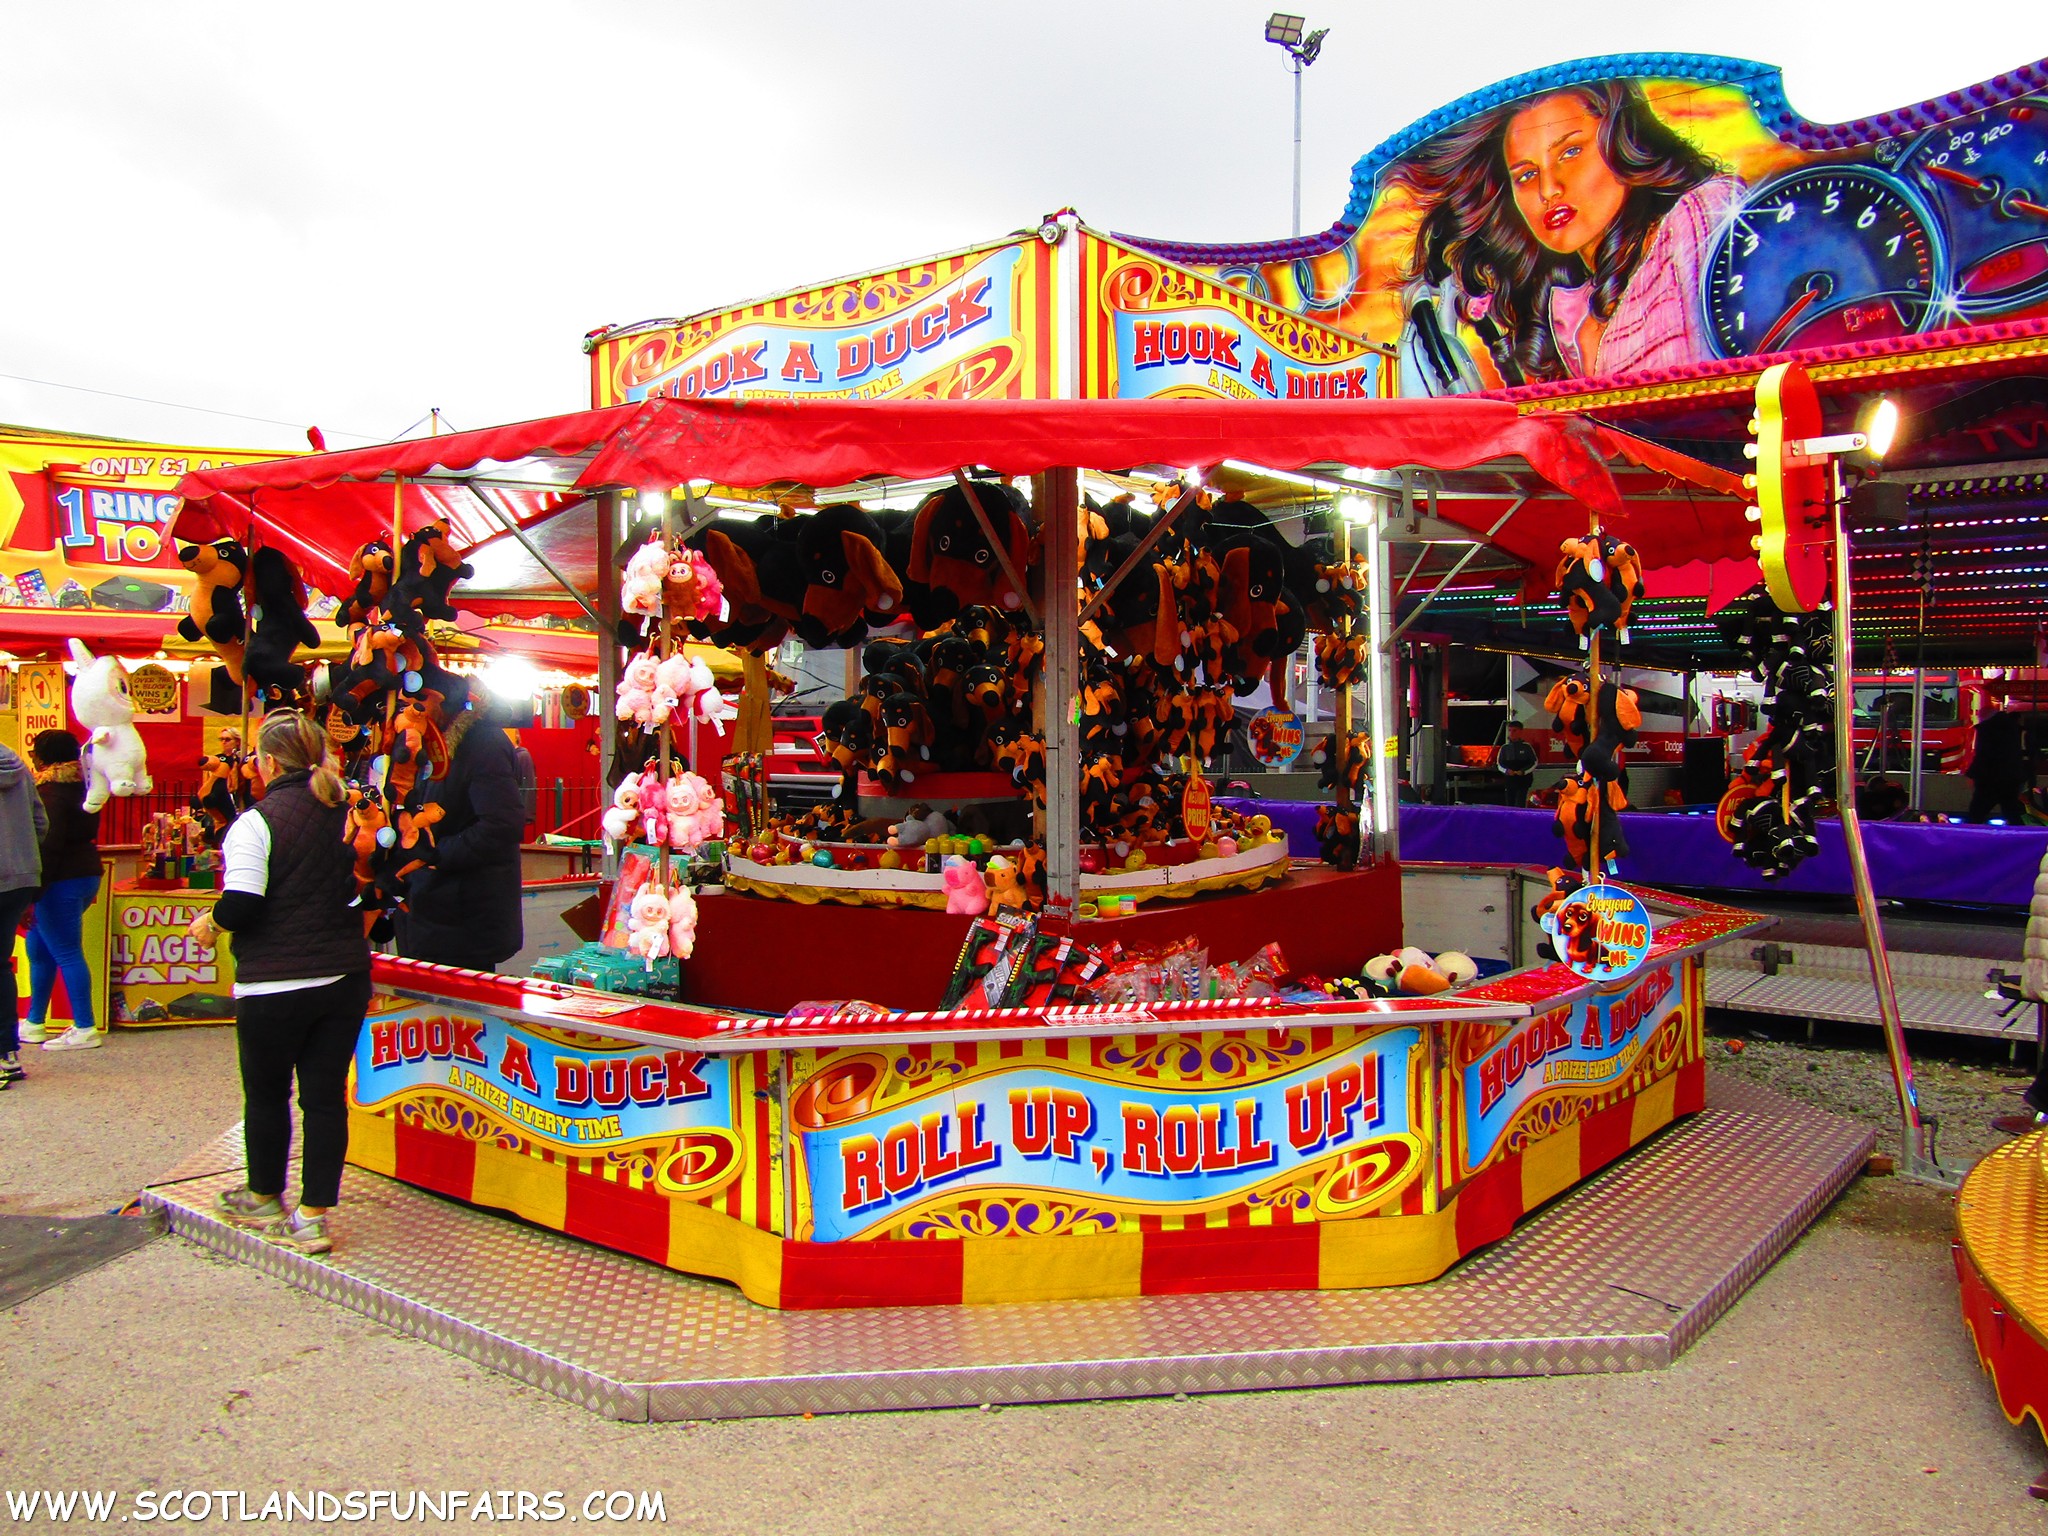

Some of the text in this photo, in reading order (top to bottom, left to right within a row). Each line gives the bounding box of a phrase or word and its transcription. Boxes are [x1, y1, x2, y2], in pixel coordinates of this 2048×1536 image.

[1949, 131, 1975, 151] 80
[1981, 124, 2013, 145] 120
[1776, 203, 1796, 223] 4
[1821, 191, 1841, 215] 5
[1856, 210, 1877, 229] 6
[1742, 233, 1760, 257] 3
[1885, 234, 1902, 258] 7
[1728, 274, 1744, 295] 2
[1735, 311, 1746, 331] 1
[646, 276, 994, 400] HOOK A DUCK
[1132, 320, 1370, 400] HOOK A DUCK
[853, 368, 904, 400] TIME
[1208, 368, 1220, 389] A
[90, 457, 155, 477] ONLY
[159, 457, 189, 476] £1
[57, 487, 178, 548] 1 RING
[35, 680, 45, 700] 1
[136, 690, 161, 698] WINS
[26, 714, 58, 730] RING
[1272, 727, 1302, 745] WINS
[1664, 740, 1683, 754] Dodge
[1187, 808, 1207, 827] PRIZE
[122, 905, 212, 929] ONLY
[1586, 892, 1635, 920] Everyone
[1597, 919, 1646, 949] WINS
[112, 934, 217, 965] LL AGES
[1479, 965, 1675, 1120] HOOK A DUCK
[370, 1014, 711, 1108] HOOK A DUCK
[1542, 1035, 1640, 1085] A PRIZE EVERY TIME
[448, 1066, 623, 1141] A PRIZE EVERY TIME
[841, 1051, 1388, 1213] ROLL UP, ROLL UP!
